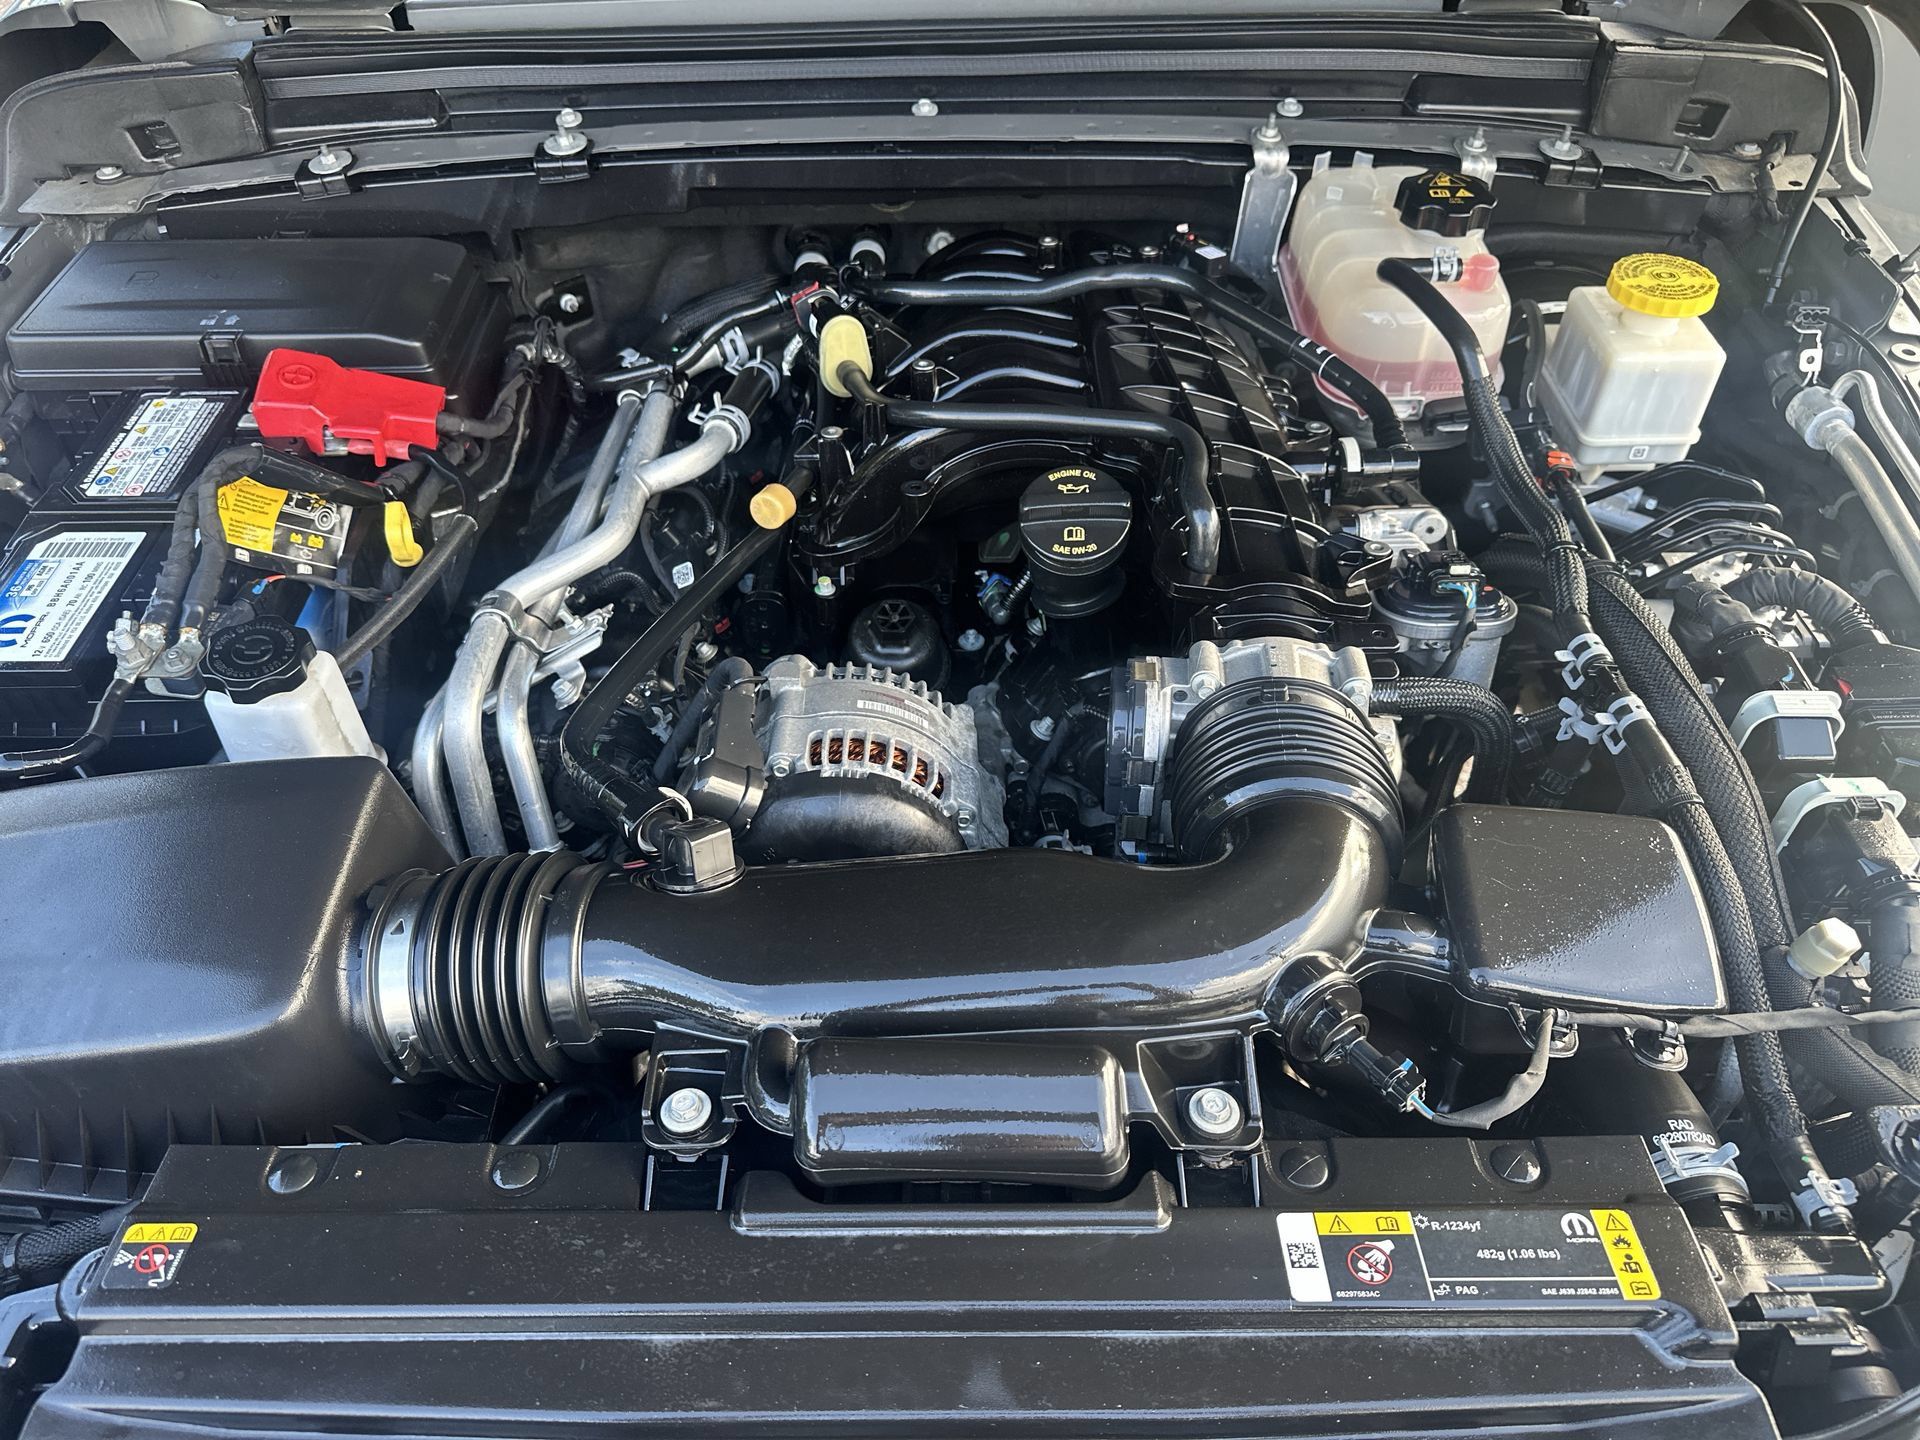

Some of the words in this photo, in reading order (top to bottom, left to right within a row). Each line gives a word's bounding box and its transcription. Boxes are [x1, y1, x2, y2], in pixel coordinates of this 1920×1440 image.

[1048, 469, 1081, 481] ENGINE
[1082, 470, 1097, 480] OIL
[1052, 544, 1071, 554] SAE
[1071, 543, 1098, 554] 0W-20
[4, 585, 22, 598] 36
[32, 649, 44, 657] 12
[66, 599, 78, 607] 70
[1667, 1119, 1695, 1131] RAD
[1431, 1221, 1481, 1232] R-1234yf
[1476, 1249, 1505, 1261] 482g
[1508, 1249, 1536, 1261] (1.06
[1538, 1249, 1561, 1261] lbs)
[1455, 1286, 1479, 1295] PAG
